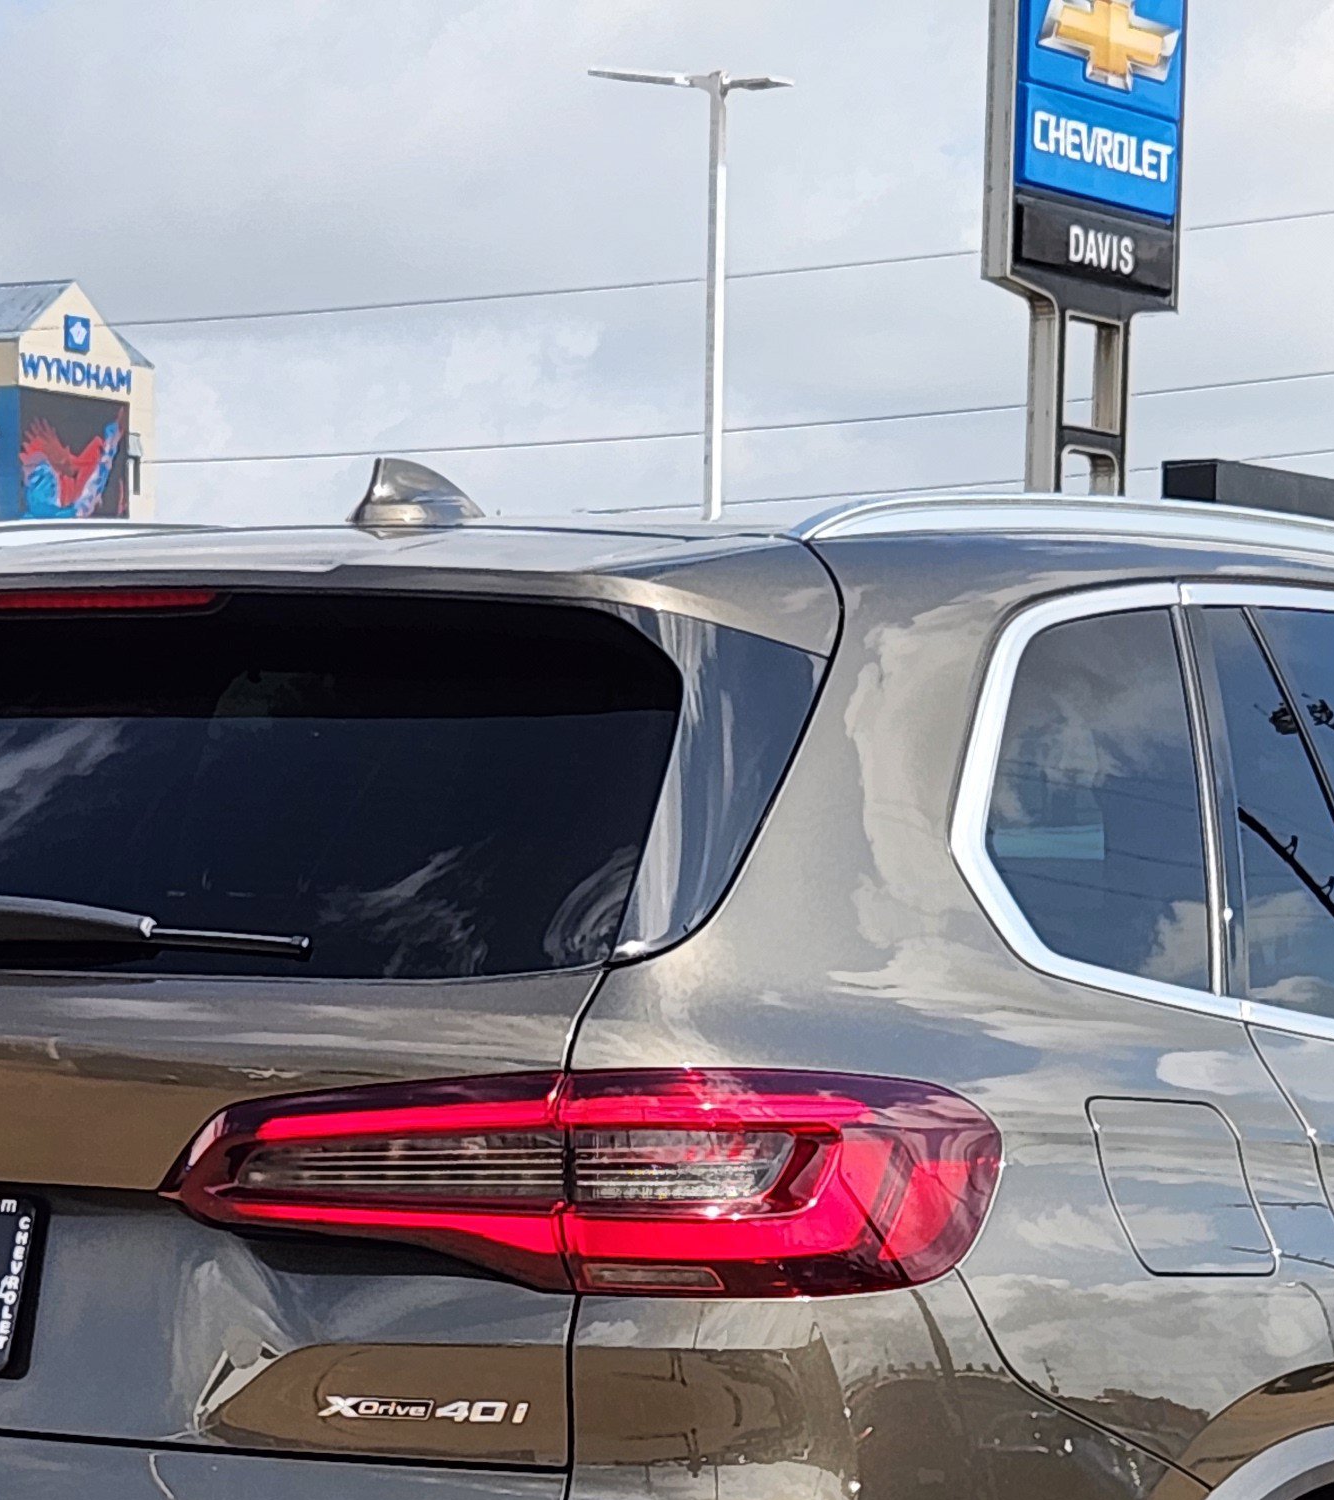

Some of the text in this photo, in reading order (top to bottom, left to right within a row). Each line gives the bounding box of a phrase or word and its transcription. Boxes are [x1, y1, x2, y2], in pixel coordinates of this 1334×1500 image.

[1033, 110, 1175, 182] CHEVROLET
[1068, 224, 1135, 275] DAVIS
[19, 352, 132, 394] WYNDHAM
